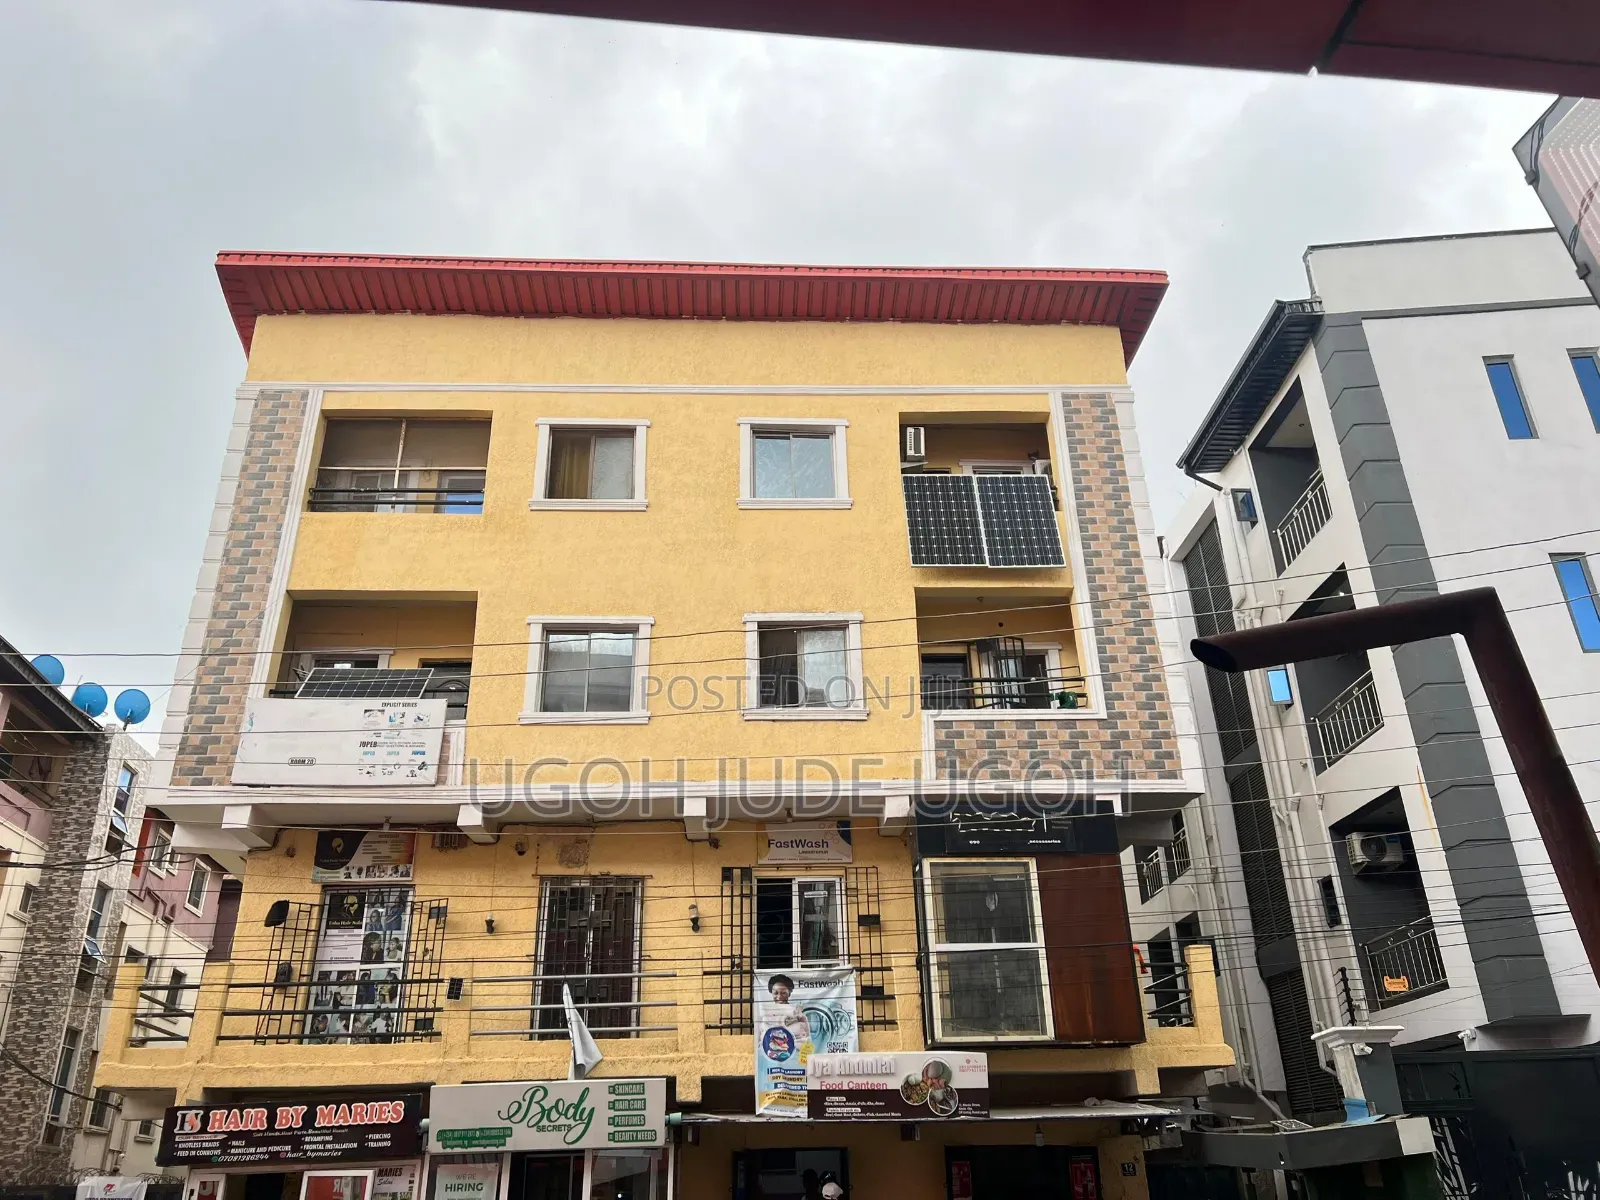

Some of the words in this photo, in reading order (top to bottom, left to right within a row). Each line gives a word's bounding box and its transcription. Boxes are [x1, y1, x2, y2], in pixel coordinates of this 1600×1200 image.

[768, 839, 829, 848] FastWash
[798, 979, 844, 988] FastWash
[614, 1084, 644, 1094] SKINCARE
[820, 1081, 844, 1090] Food
[847, 1080, 888, 1090] Canteen
[614, 1100, 629, 1110] HAIR
[630, 1100, 645, 1109] CARE
[207, 1108, 268, 1132] HAIR
[275, 1105, 307, 1129] BY
[315, 1100, 404, 1127] MARIES
[498, 1085, 595, 1145] Body
[614, 1115, 645, 1126] PERFUMES
[536, 1124, 572, 1132] SECRETS
[614, 1131, 636, 1141] BEAUTY
[637, 1131, 656, 1140] NEEDS
[377, 1167, 403, 1177] MARIES
[1123, 1163, 1134, 1171] 12
[445, 1183, 484, 1192] HIRING
